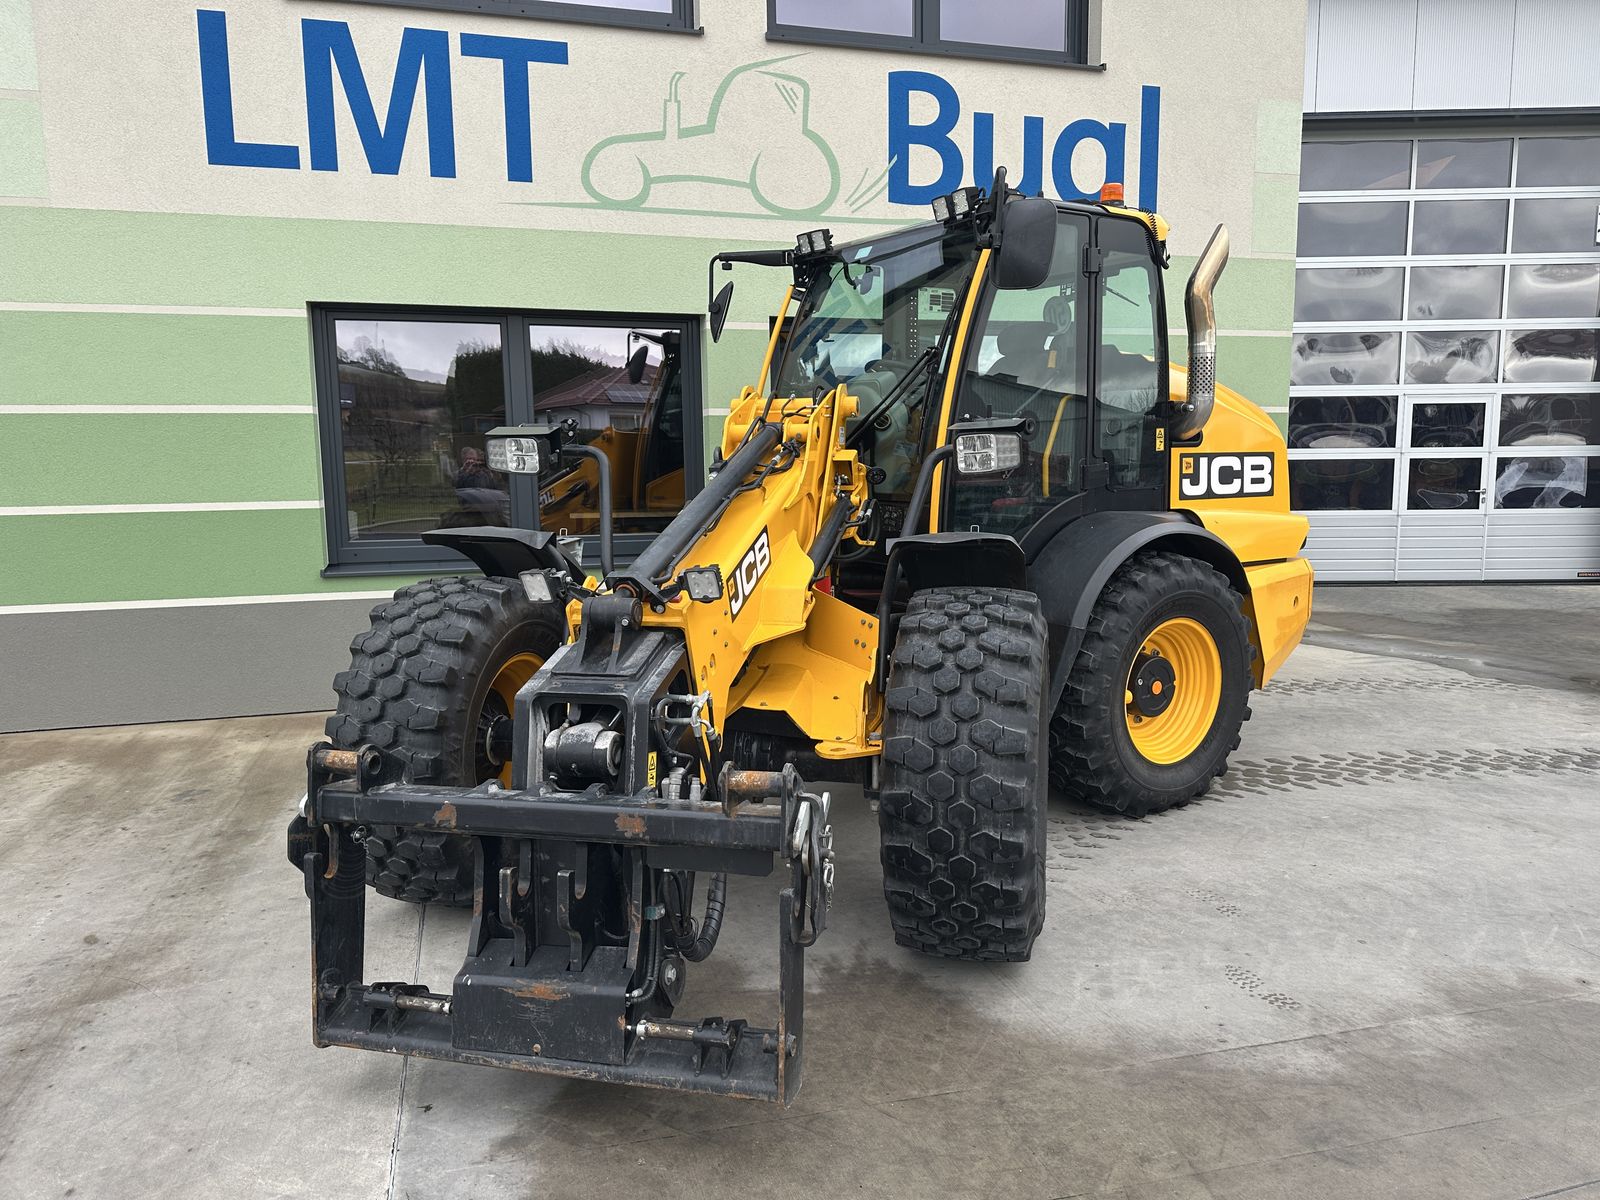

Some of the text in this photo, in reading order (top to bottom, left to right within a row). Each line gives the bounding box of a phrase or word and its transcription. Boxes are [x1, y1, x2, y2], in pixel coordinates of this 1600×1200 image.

[197, 9, 568, 183] LMT
[1181, 455, 1273, 496] JCB
[730, 531, 770, 615] JCB
